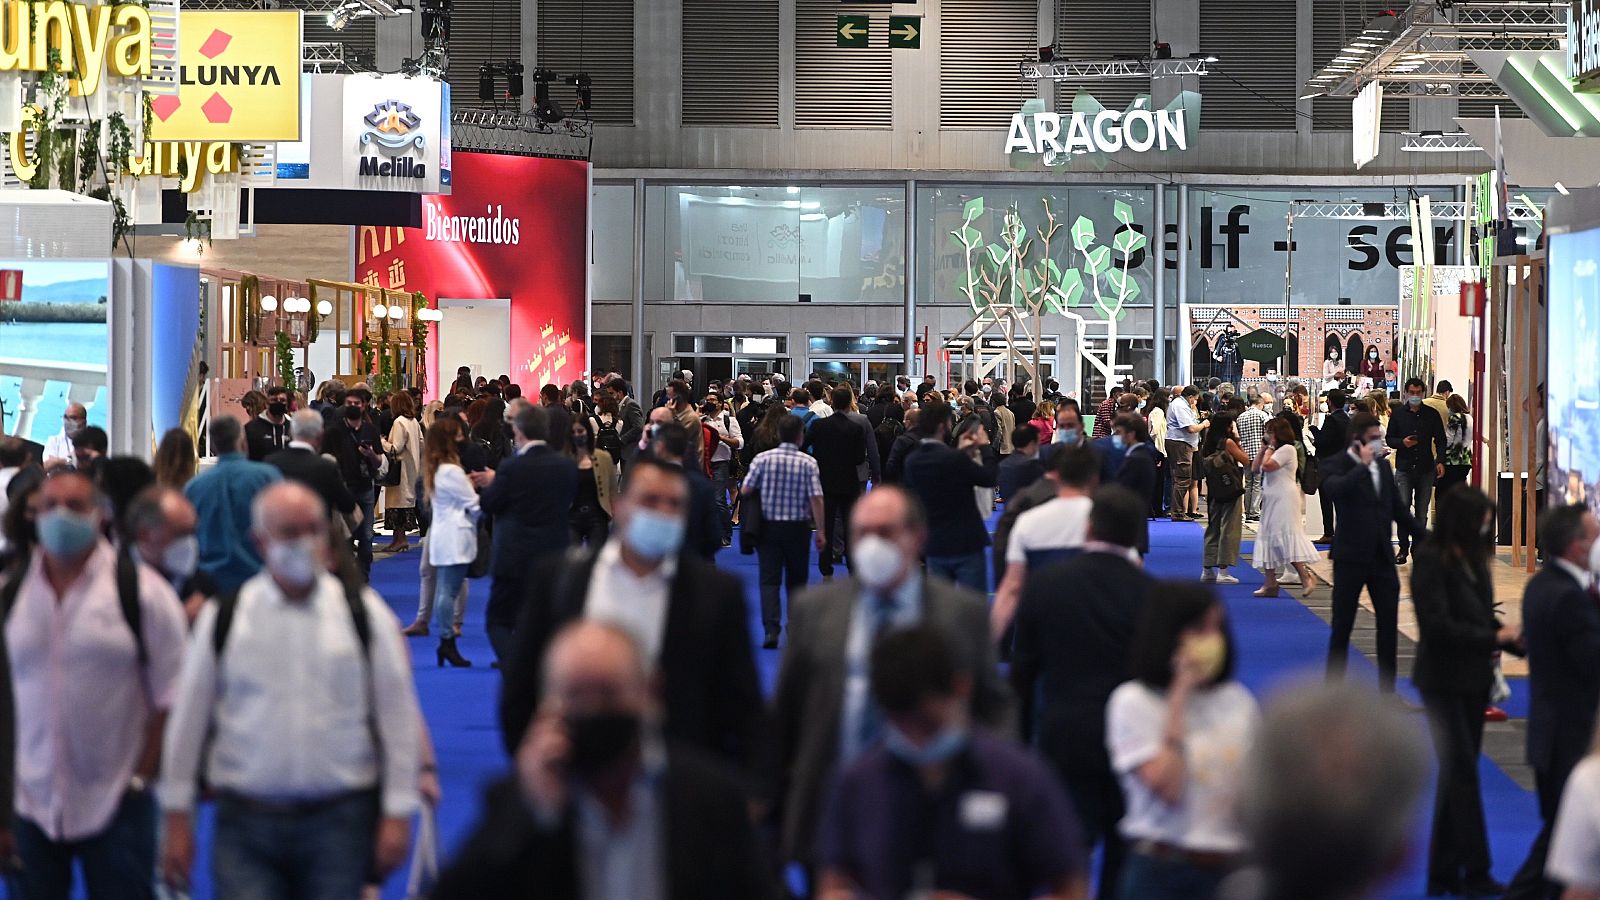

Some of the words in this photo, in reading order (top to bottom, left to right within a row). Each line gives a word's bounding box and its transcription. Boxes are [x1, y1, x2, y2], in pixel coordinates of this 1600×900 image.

[1004, 98, 1188, 154] ARAGÓN
[359, 156, 426, 179] Melilla
[425, 202, 520, 245] Bienvenidos
